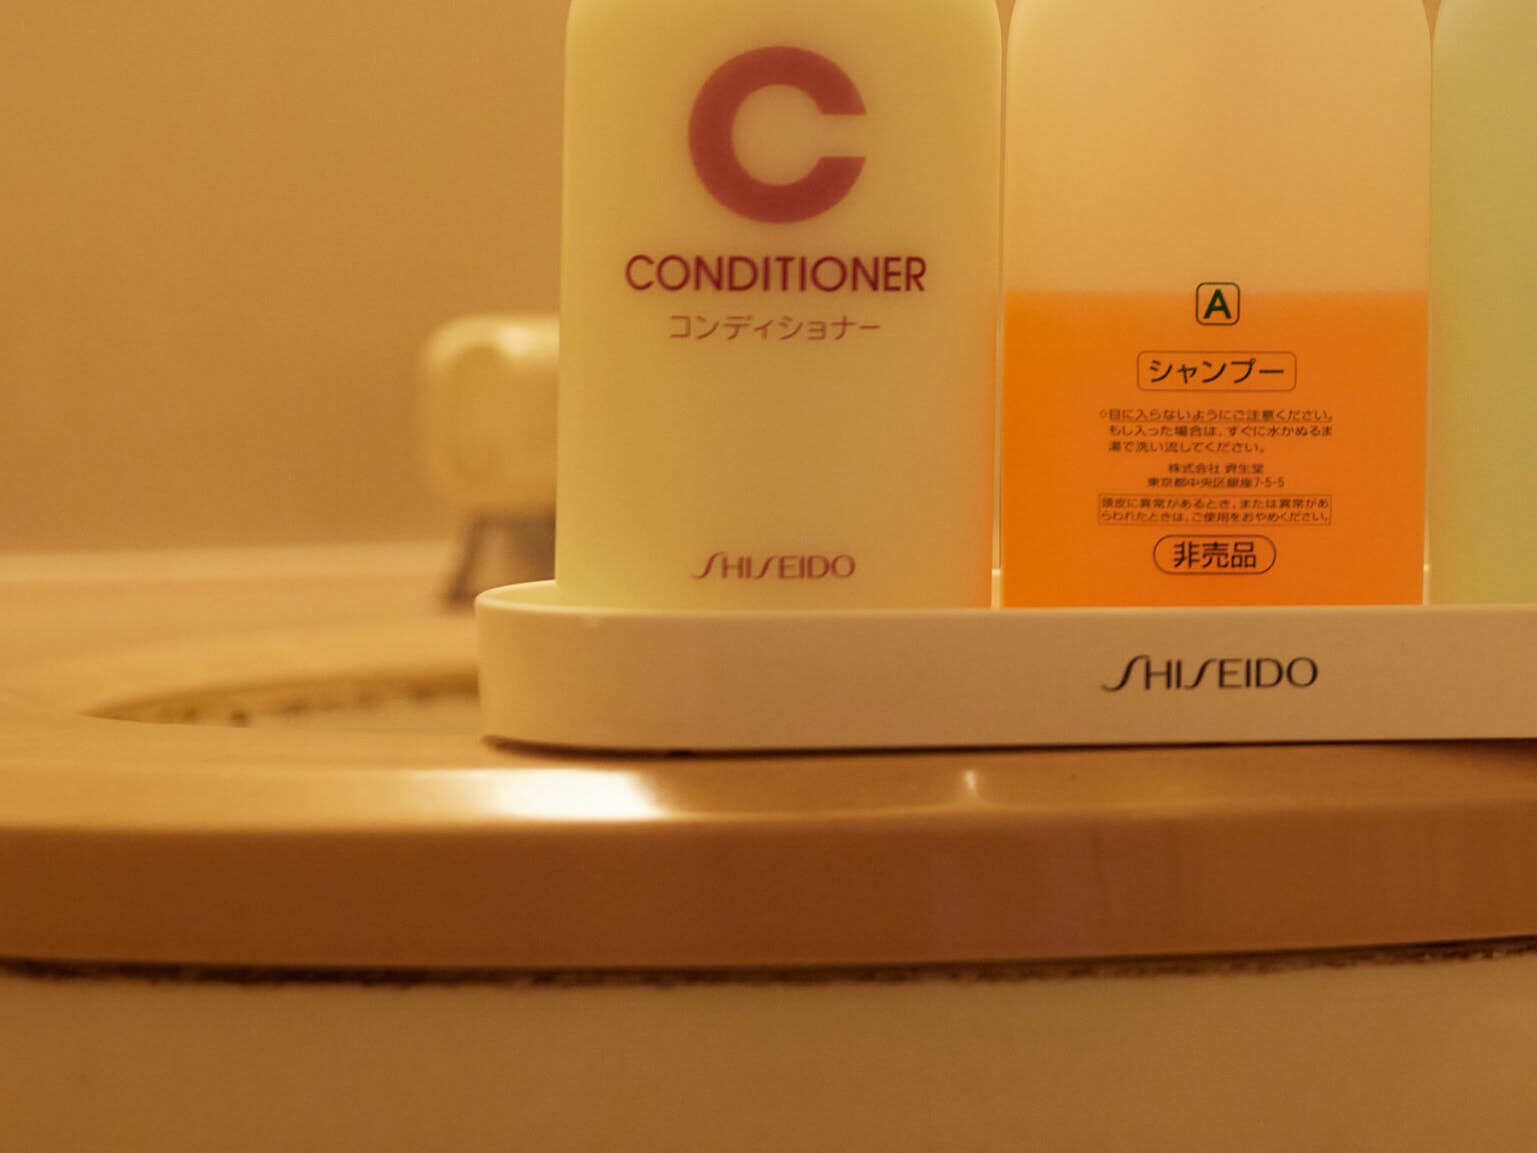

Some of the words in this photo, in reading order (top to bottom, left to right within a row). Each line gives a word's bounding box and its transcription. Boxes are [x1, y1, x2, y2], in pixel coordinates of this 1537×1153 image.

[689, 46, 867, 225] C
[625, 254, 927, 293] CONDITIONER
[1203, 289, 1232, 319] A
[669, 316, 881, 340] コンディショナー
[1149, 358, 1285, 384] シャンプー
[693, 552, 856, 581] SHISEIDO
[1173, 542, 1257, 568] 非売品
[1101, 654, 1319, 692] SHISEIDO
